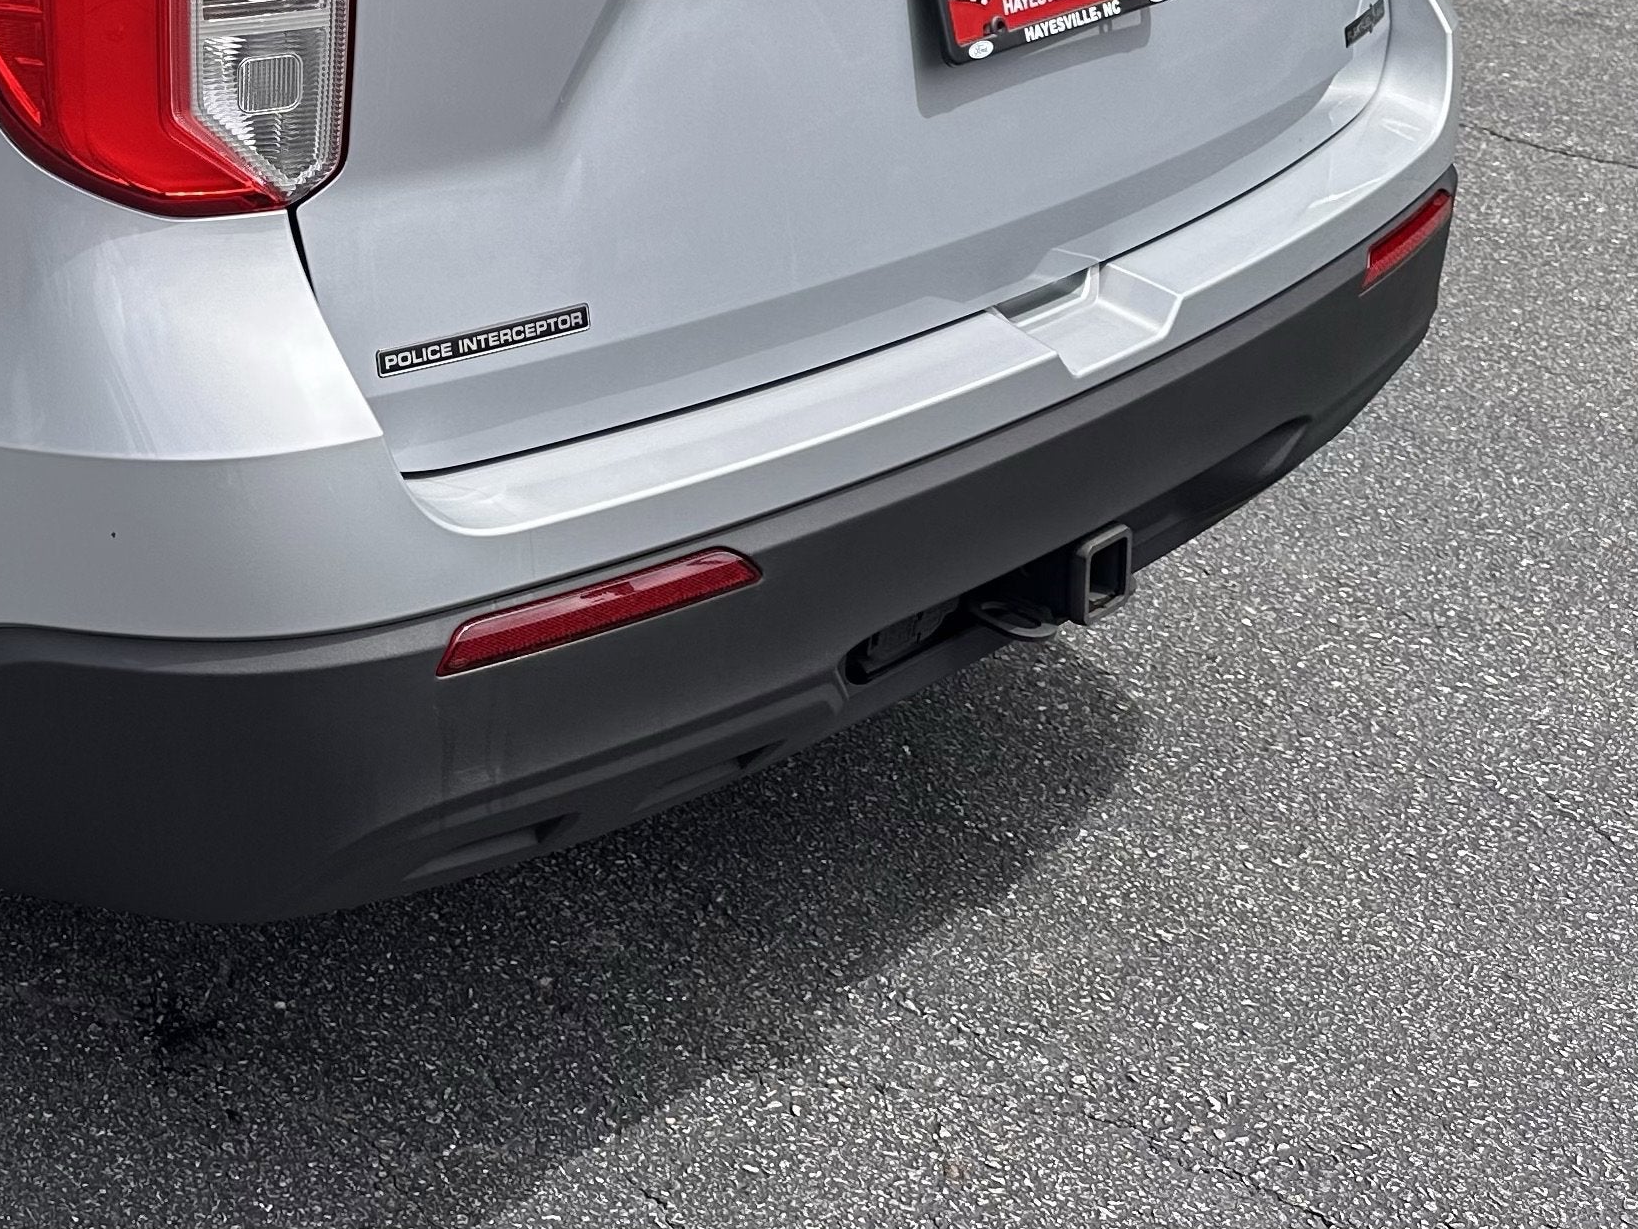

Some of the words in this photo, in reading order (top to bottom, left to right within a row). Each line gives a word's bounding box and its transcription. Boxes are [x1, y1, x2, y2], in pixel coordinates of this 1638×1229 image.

[1024, 6, 1102, 43] HAYESVILLE,
[1102, 0, 1122, 18] NC
[384, 342, 454, 371] POLICE
[458, 311, 583, 354] INTERCEPTOR
